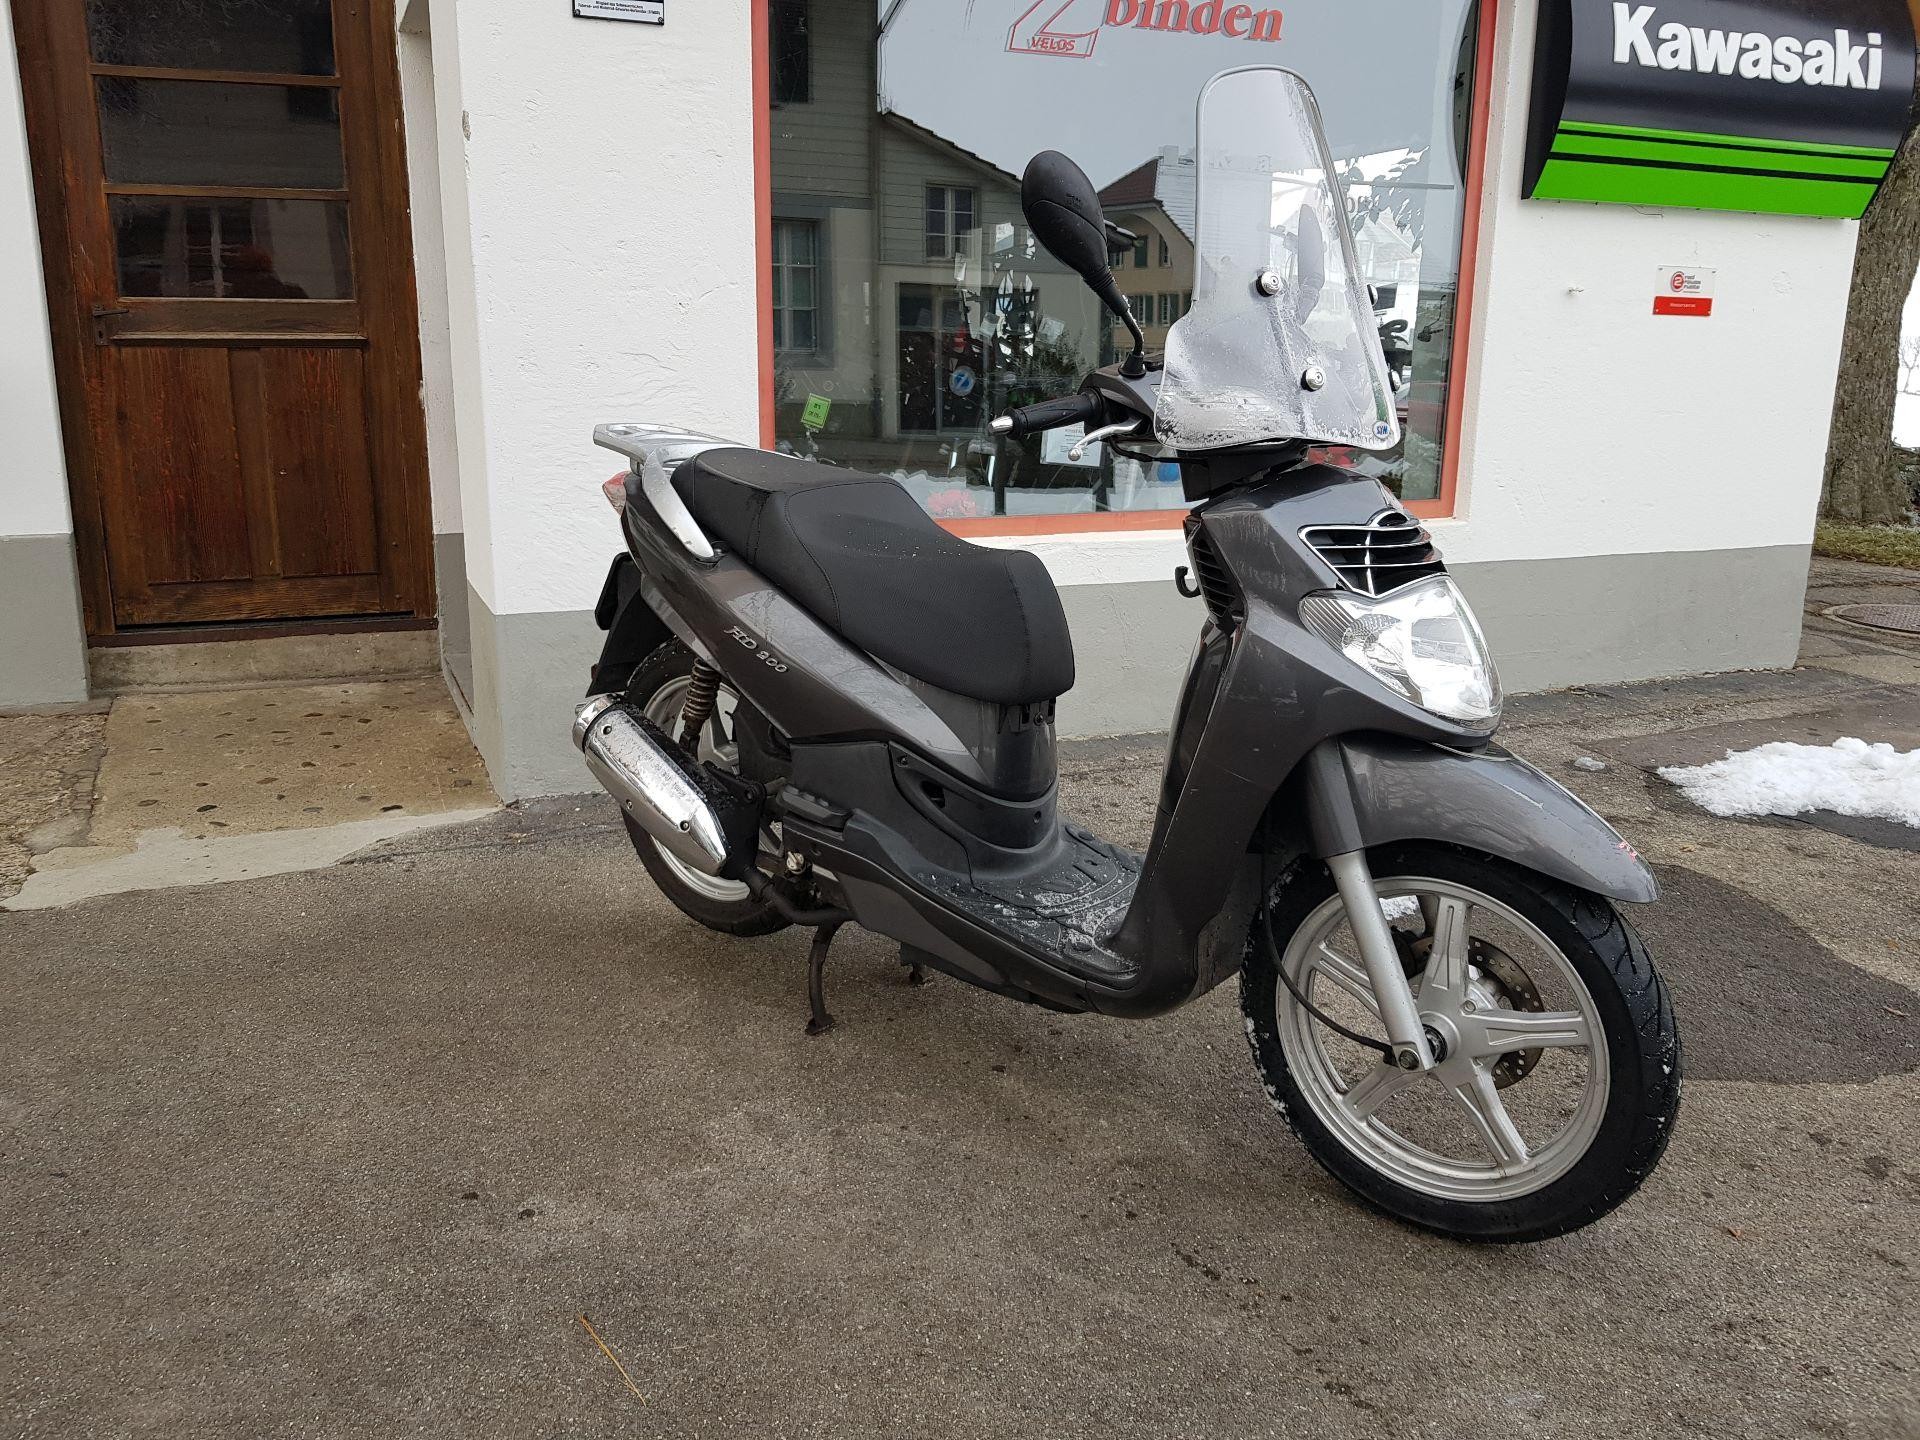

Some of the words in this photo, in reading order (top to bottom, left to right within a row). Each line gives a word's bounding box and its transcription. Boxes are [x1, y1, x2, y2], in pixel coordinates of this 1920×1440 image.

[1030, 36, 1076, 51] VELOS
[1612, 1, 1883, 91] Kawasaki
[723, 625, 758, 650] HD
[756, 650, 788, 673] 200
